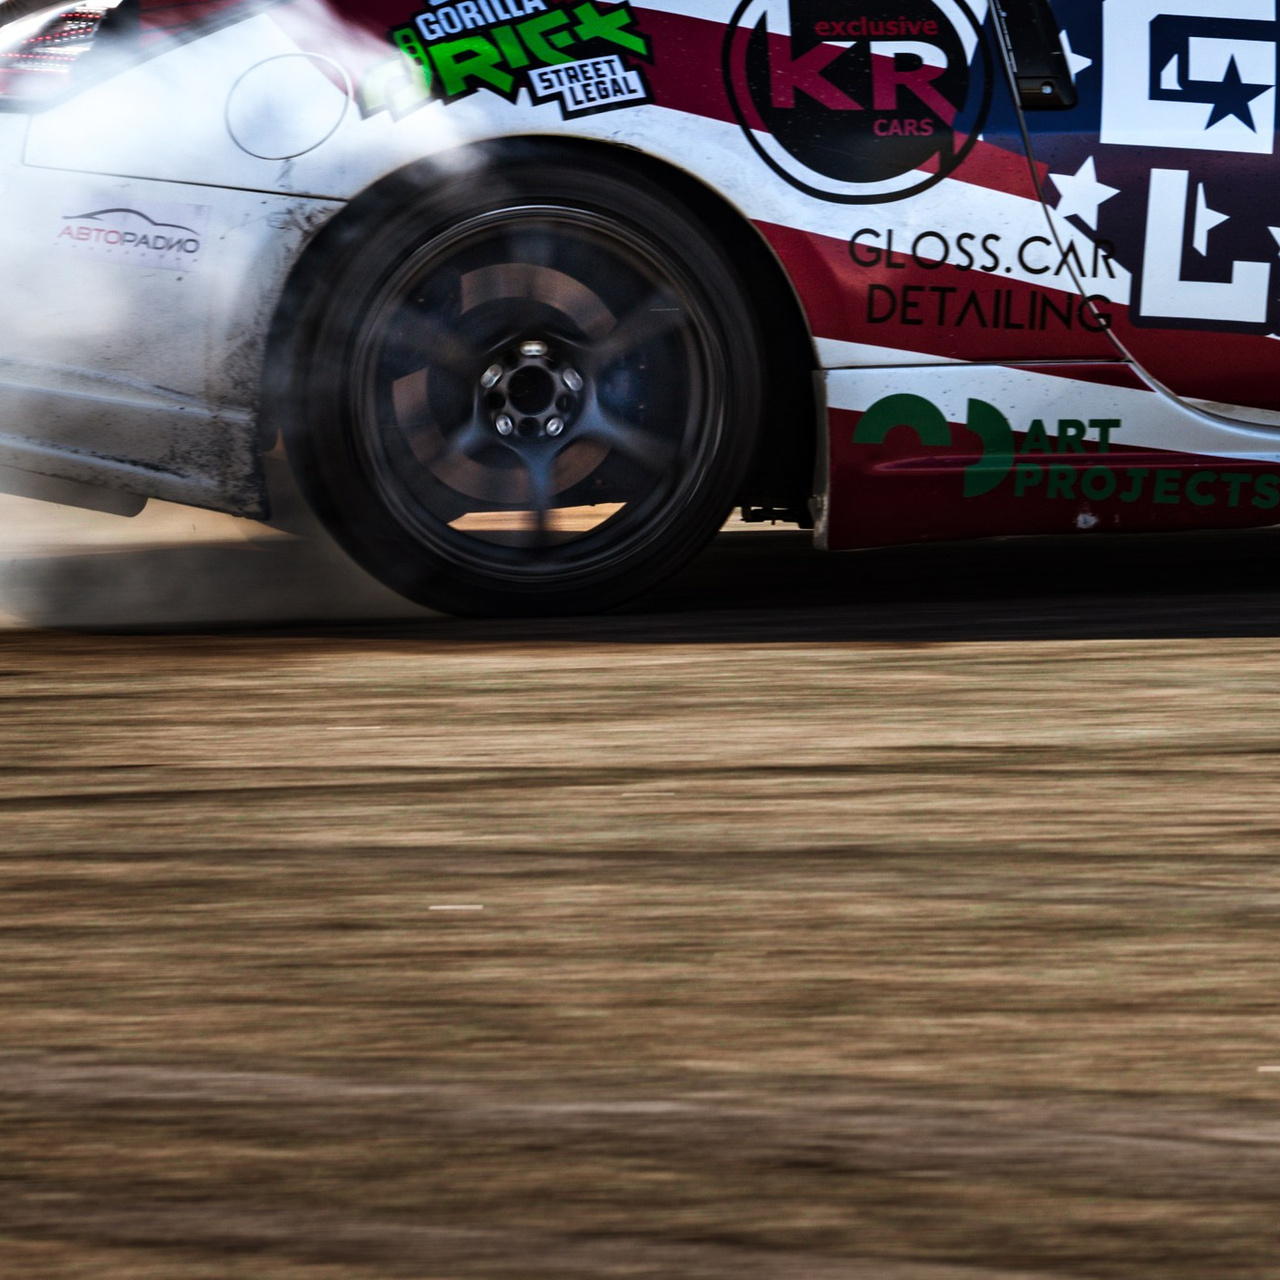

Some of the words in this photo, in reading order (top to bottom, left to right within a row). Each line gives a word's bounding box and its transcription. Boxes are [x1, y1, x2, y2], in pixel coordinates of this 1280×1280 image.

[814, 16, 939, 36] exclusive
[537, 58, 619, 91] STREET
[765, 5, 958, 128] KR
[567, 75, 638, 106] LEGAL
[873, 118, 934, 137] CARS
[848, 227, 1117, 279] GLOSS.CAR
[866, 283, 1112, 333] DETAILING
[1018, 418, 1122, 455] ART
